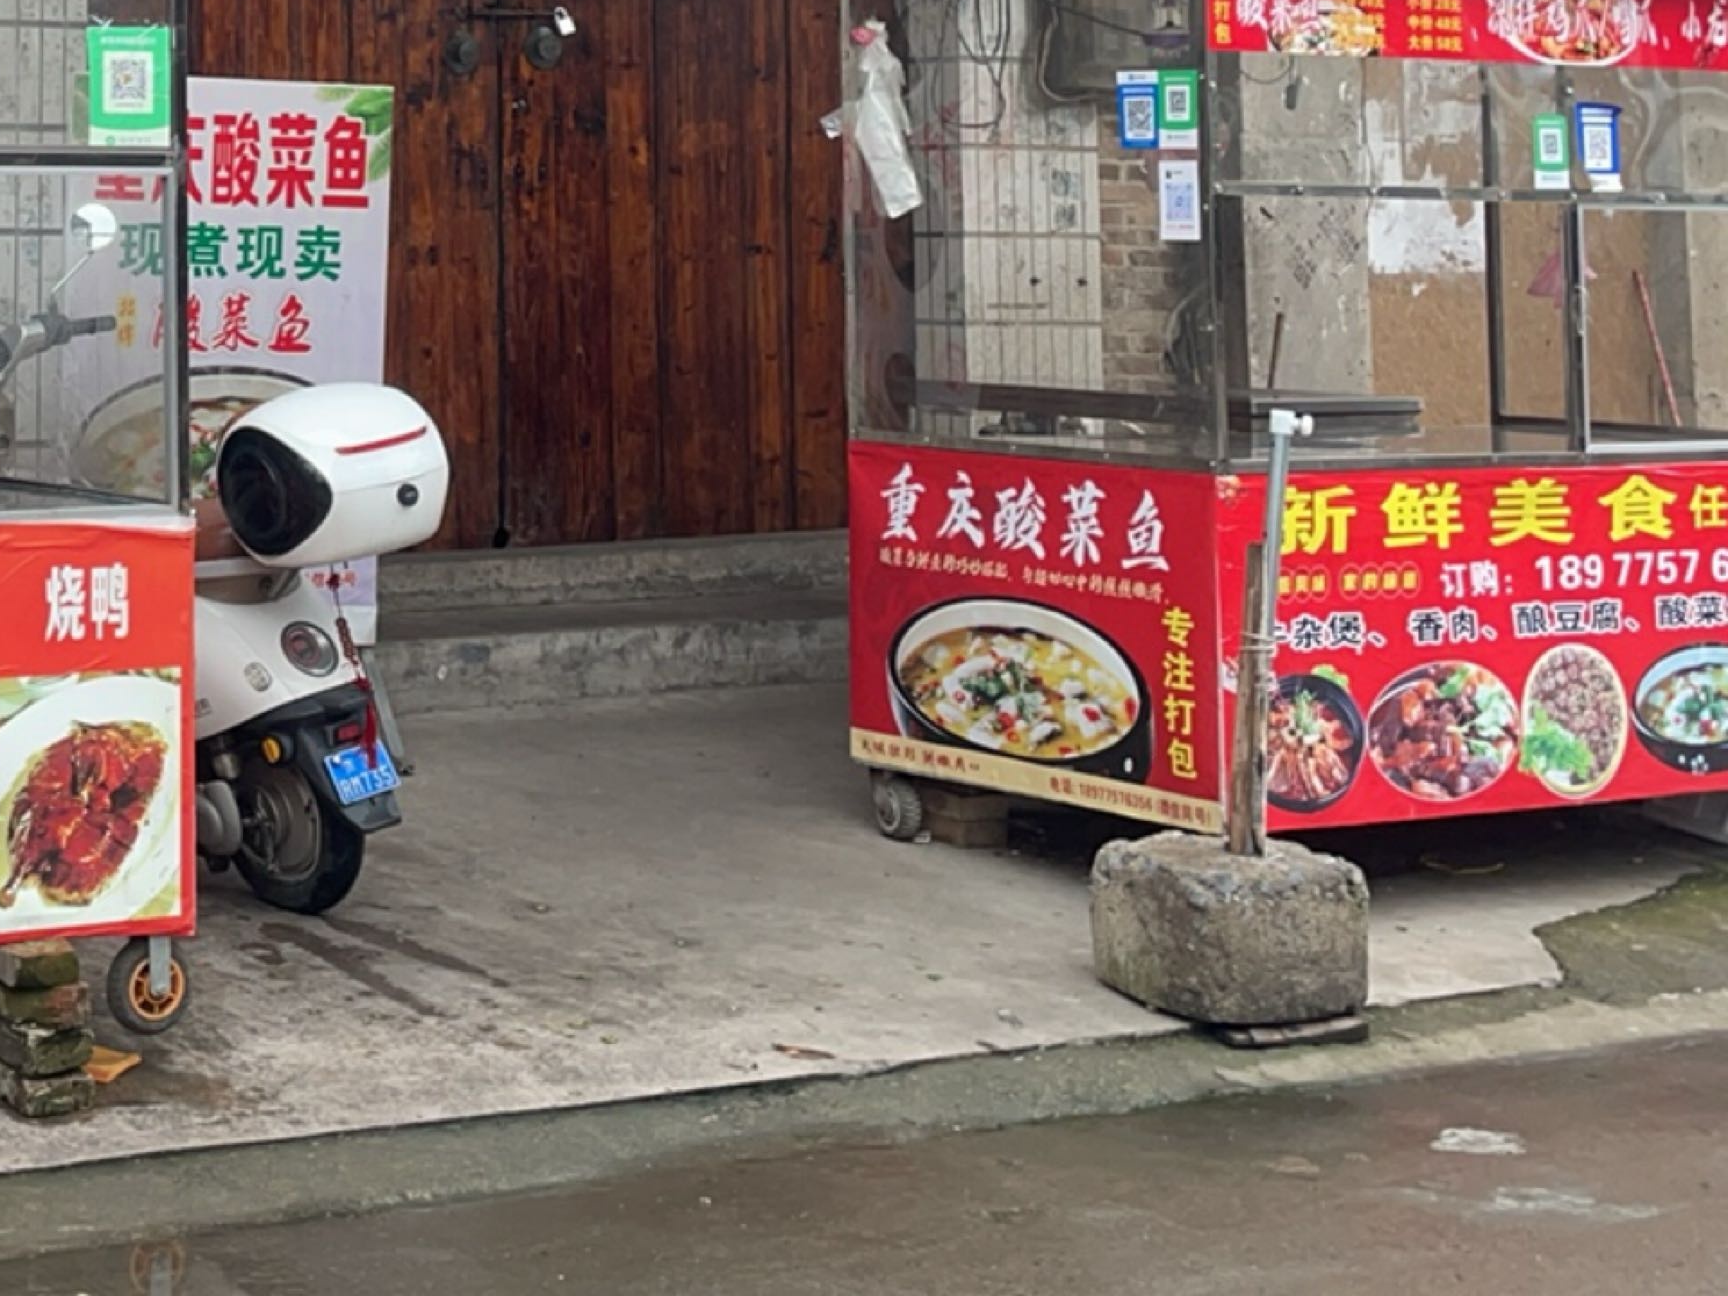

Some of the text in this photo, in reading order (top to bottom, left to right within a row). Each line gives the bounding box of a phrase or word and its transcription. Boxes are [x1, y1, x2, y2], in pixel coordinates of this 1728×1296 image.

[119, 220, 343, 282] 现煮现卖
[879, 461, 1170, 572] 重庆酸菜鱼
[1280, 474, 1677, 555] 新鲜美食
[44, 561, 130, 642] 烧鸭
[1161, 606, 1197, 780] 专注打包
